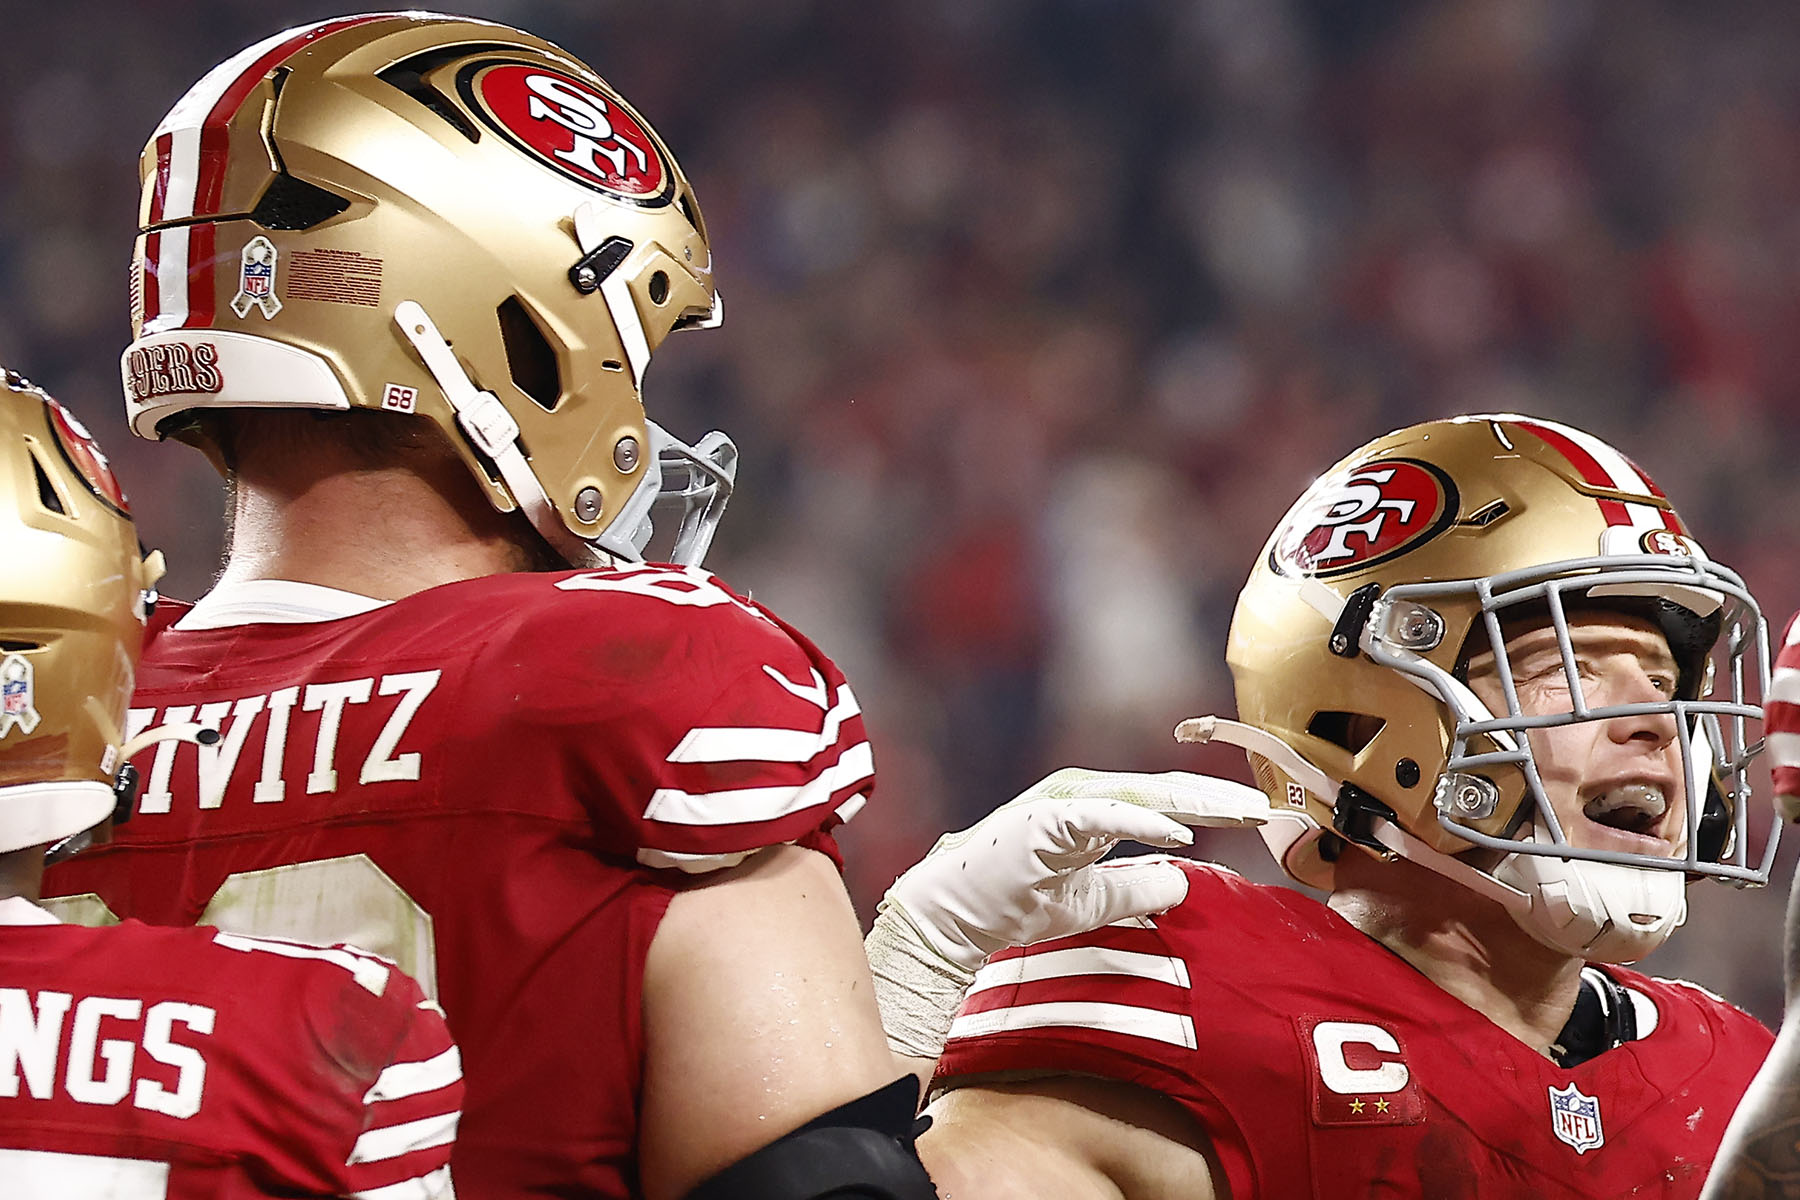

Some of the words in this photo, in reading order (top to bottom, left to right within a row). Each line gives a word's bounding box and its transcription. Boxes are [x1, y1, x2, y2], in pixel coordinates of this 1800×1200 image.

[244, 277, 269, 294] NFL
[387, 386, 414, 410] 68
[1289, 785, 1304, 806] 23
[0, 987, 217, 1120] NGS
[1312, 1021, 1410, 1095] C
[1559, 1111, 1596, 1141] NFL
